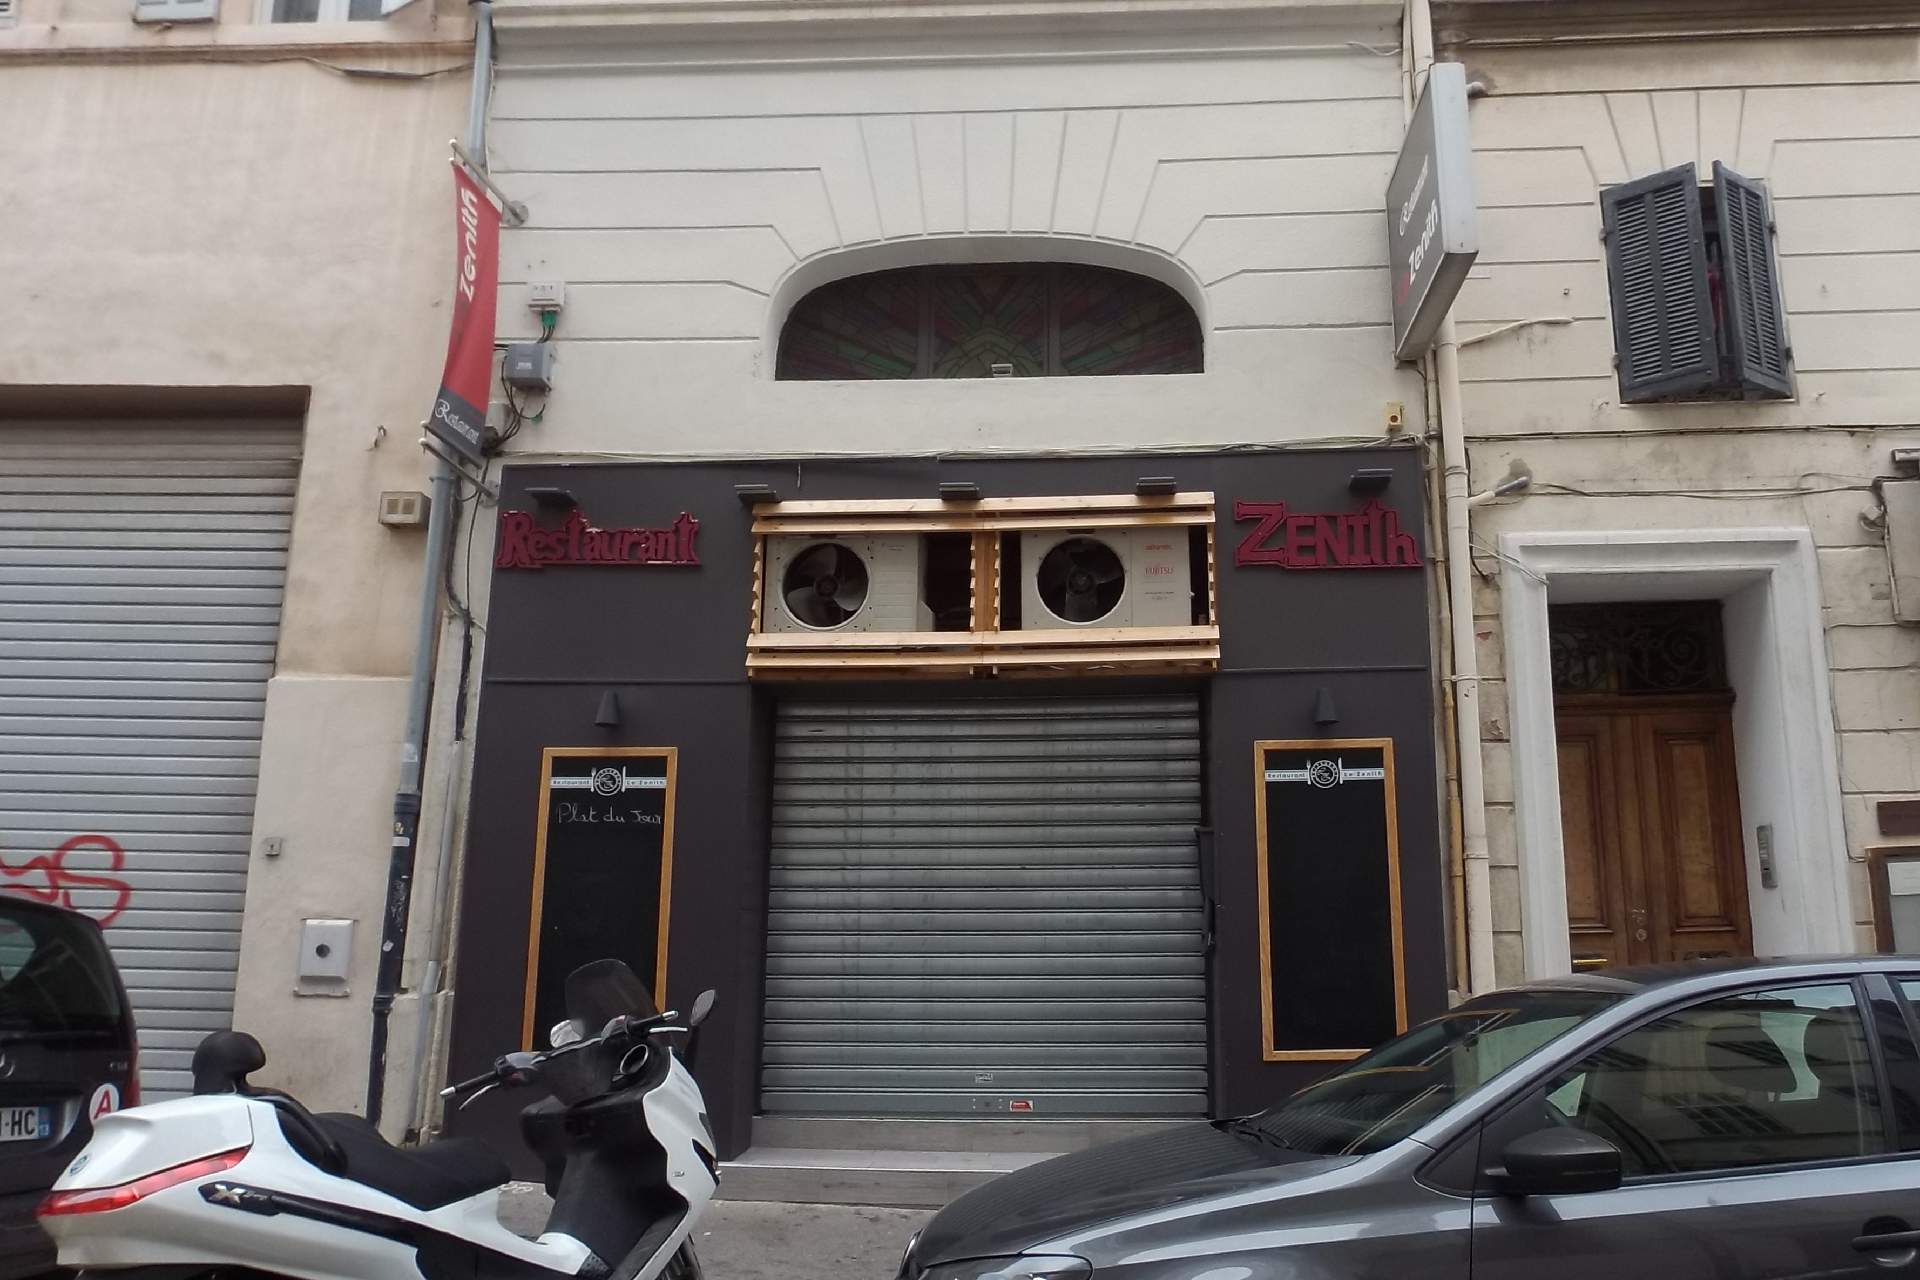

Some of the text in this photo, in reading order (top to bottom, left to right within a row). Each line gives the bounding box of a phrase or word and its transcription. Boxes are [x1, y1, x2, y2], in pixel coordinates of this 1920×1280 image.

[497, 508, 700, 568] Restaurant
[603, 805, 626, 823] du
[94, 1089, 112, 1119] A
